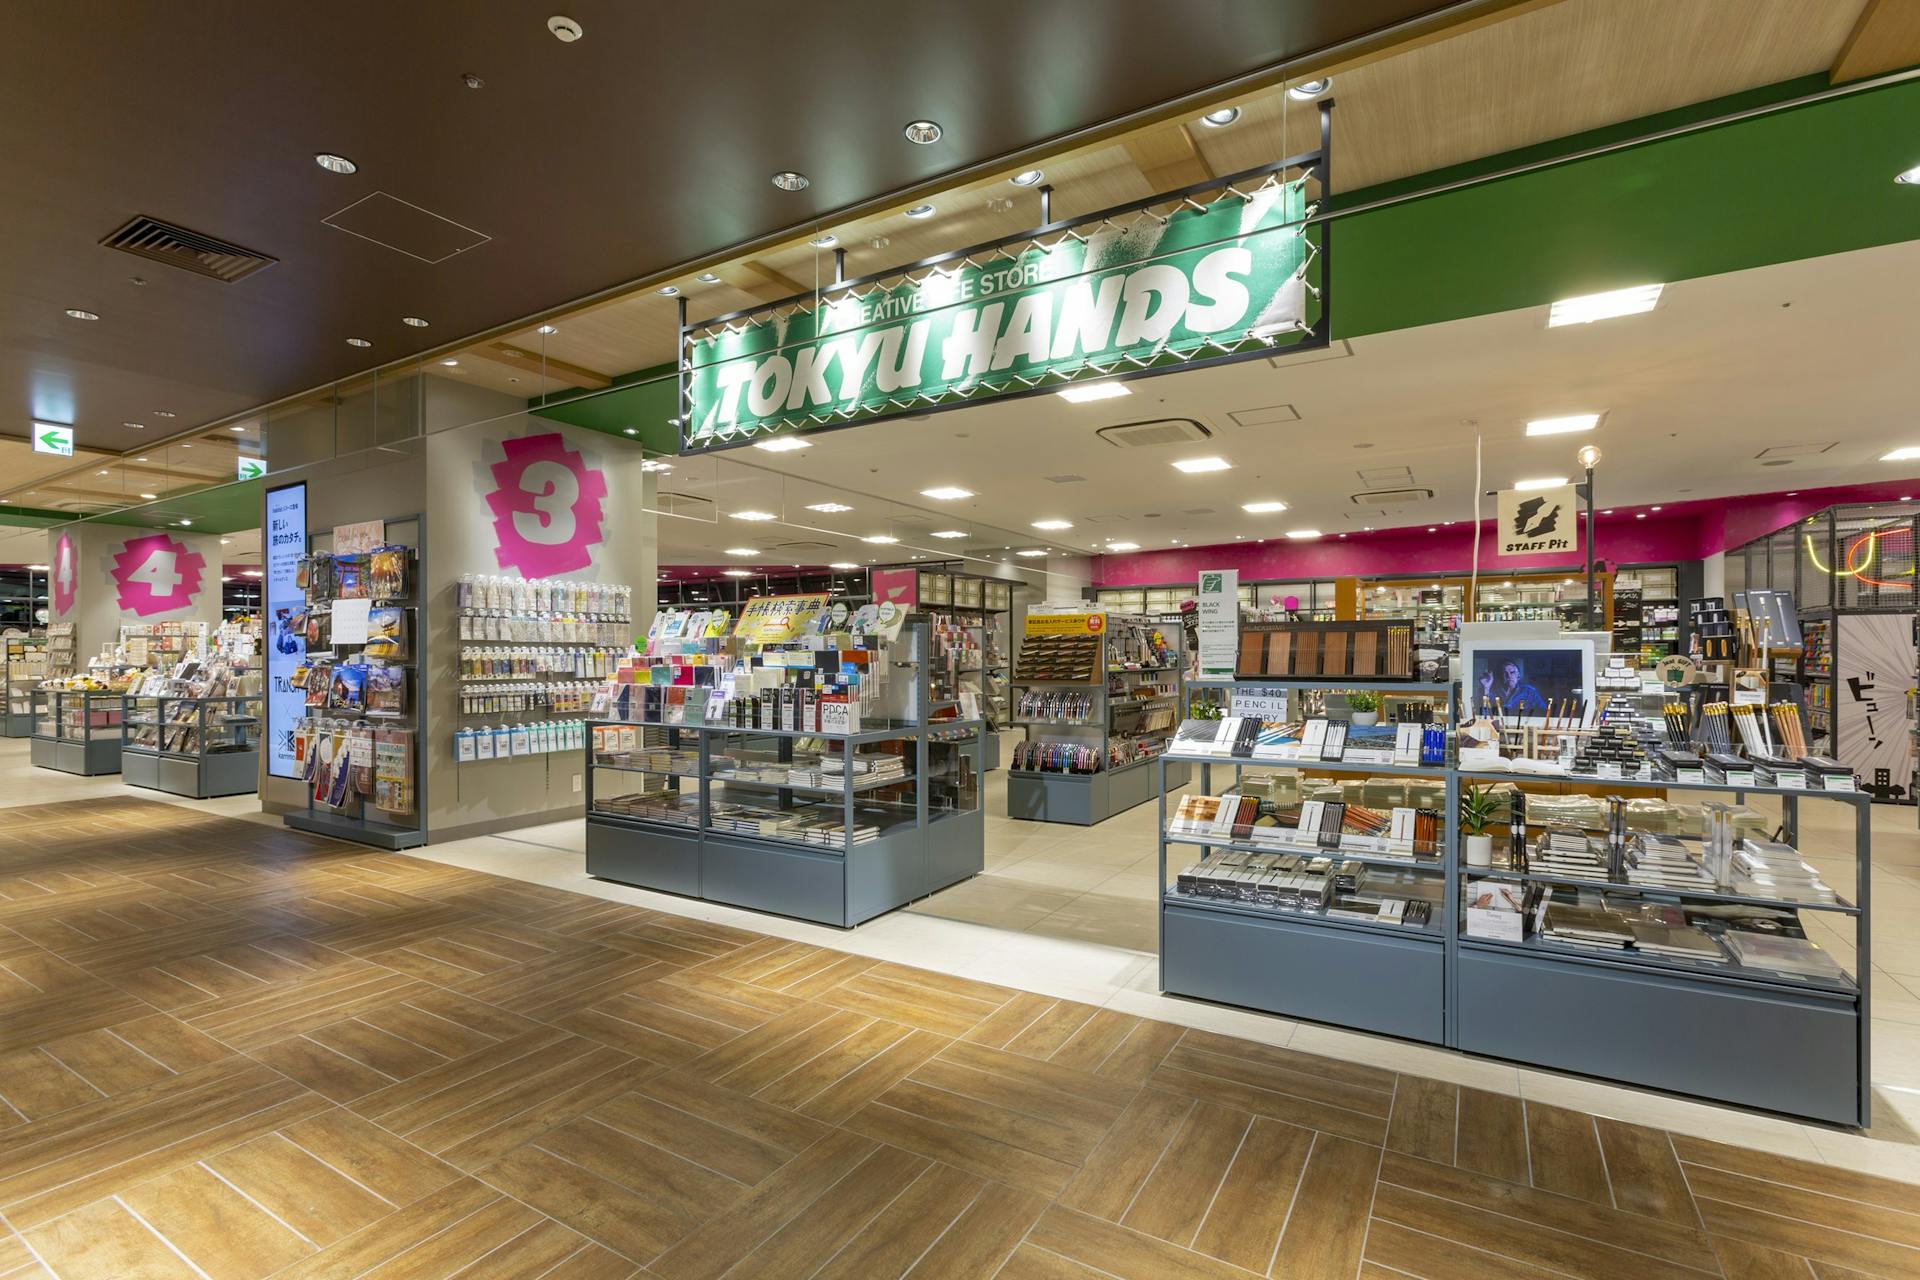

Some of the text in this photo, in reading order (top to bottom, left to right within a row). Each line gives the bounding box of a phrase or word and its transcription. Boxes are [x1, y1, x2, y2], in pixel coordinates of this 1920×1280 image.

[850, 293, 923, 327] EATIVE
[716, 248, 1253, 424] TOKYU HANDS
[512, 460, 579, 545] 3
[1506, 539, 1568, 552] STAFF Pit
[127, 550, 183, 597] 4
[747, 598, 821, 618] 手帳検索事典
[1236, 688, 1282, 697] THE $40
[823, 704, 849, 716] PDCA
[1235, 699, 1283, 710] PENCIL
